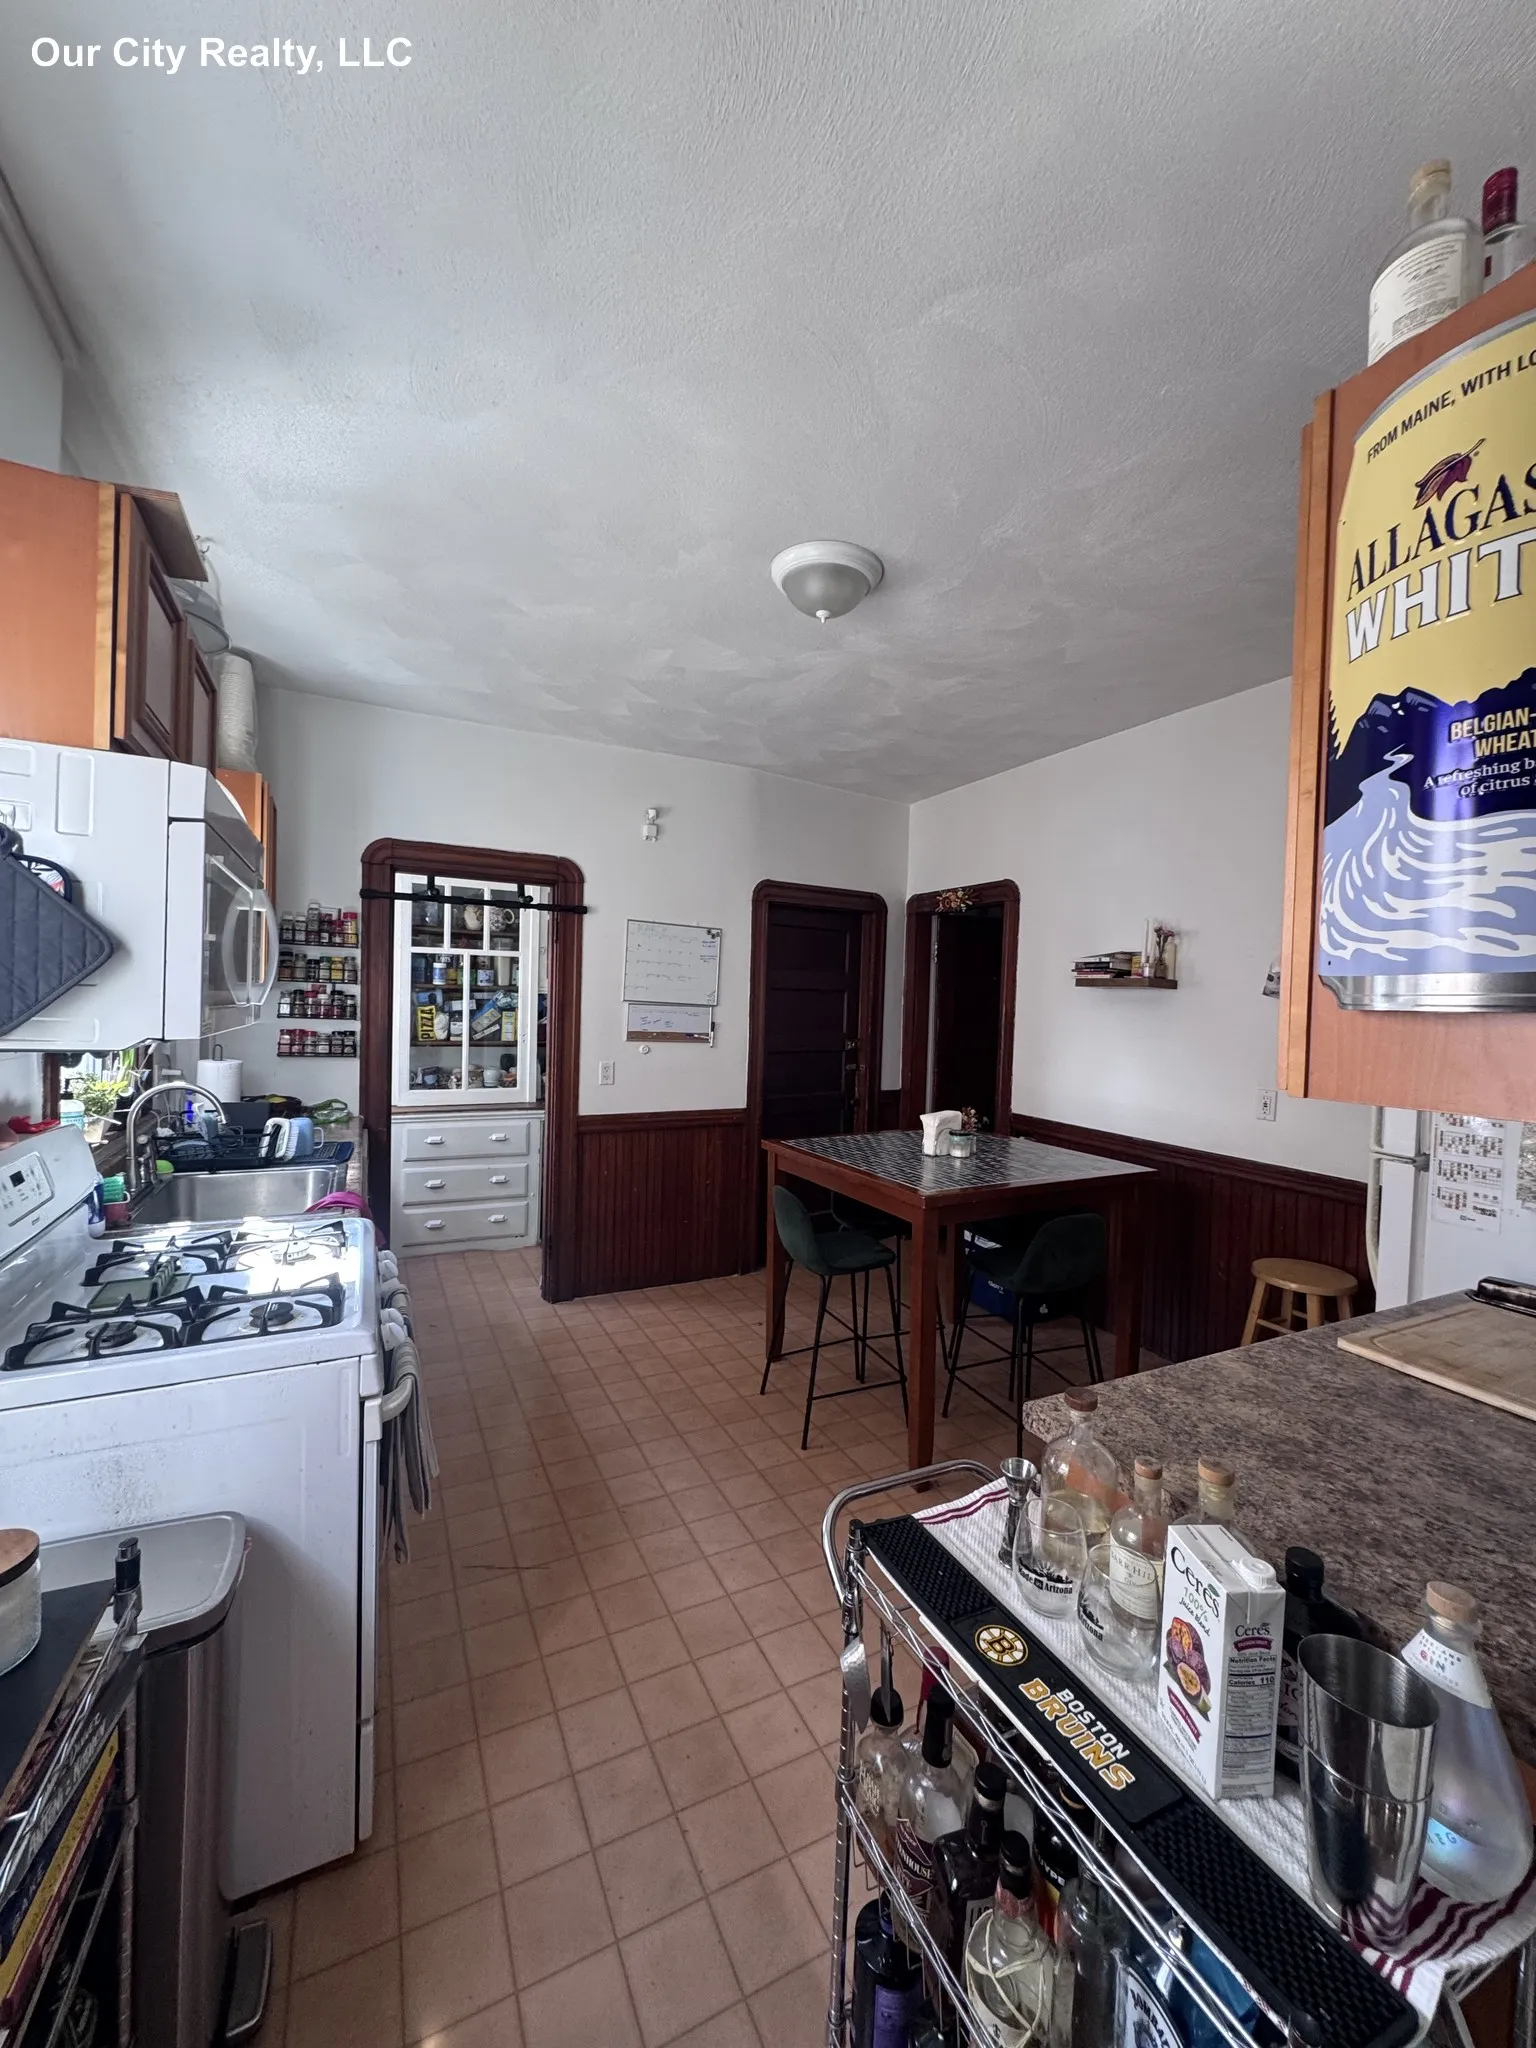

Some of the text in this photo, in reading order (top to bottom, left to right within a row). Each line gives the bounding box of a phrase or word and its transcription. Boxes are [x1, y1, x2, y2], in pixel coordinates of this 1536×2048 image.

[1367, 425, 1398, 464] FROM
[1401, 391, 1455, 436] MAINE,
[1461, 360, 1511, 397] WITH
[1423, 775, 1436, 789] A
[1437, 760, 1522, 785] refreshing
[1460, 775, 1531, 797] of citrus
[420, 1007, 436, 1040] PIZZA
[1044, 1583, 1074, 1595] Arizona
[1183, 1586, 1209, 1622] 100%
[1230, 1655, 1276, 1664] Nutrition Facts
[1259, 1676, 1275, 1685] 110
[1019, 1676, 1136, 1791] BRUINS
[1056, 1687, 1131, 1760] BOSTON
